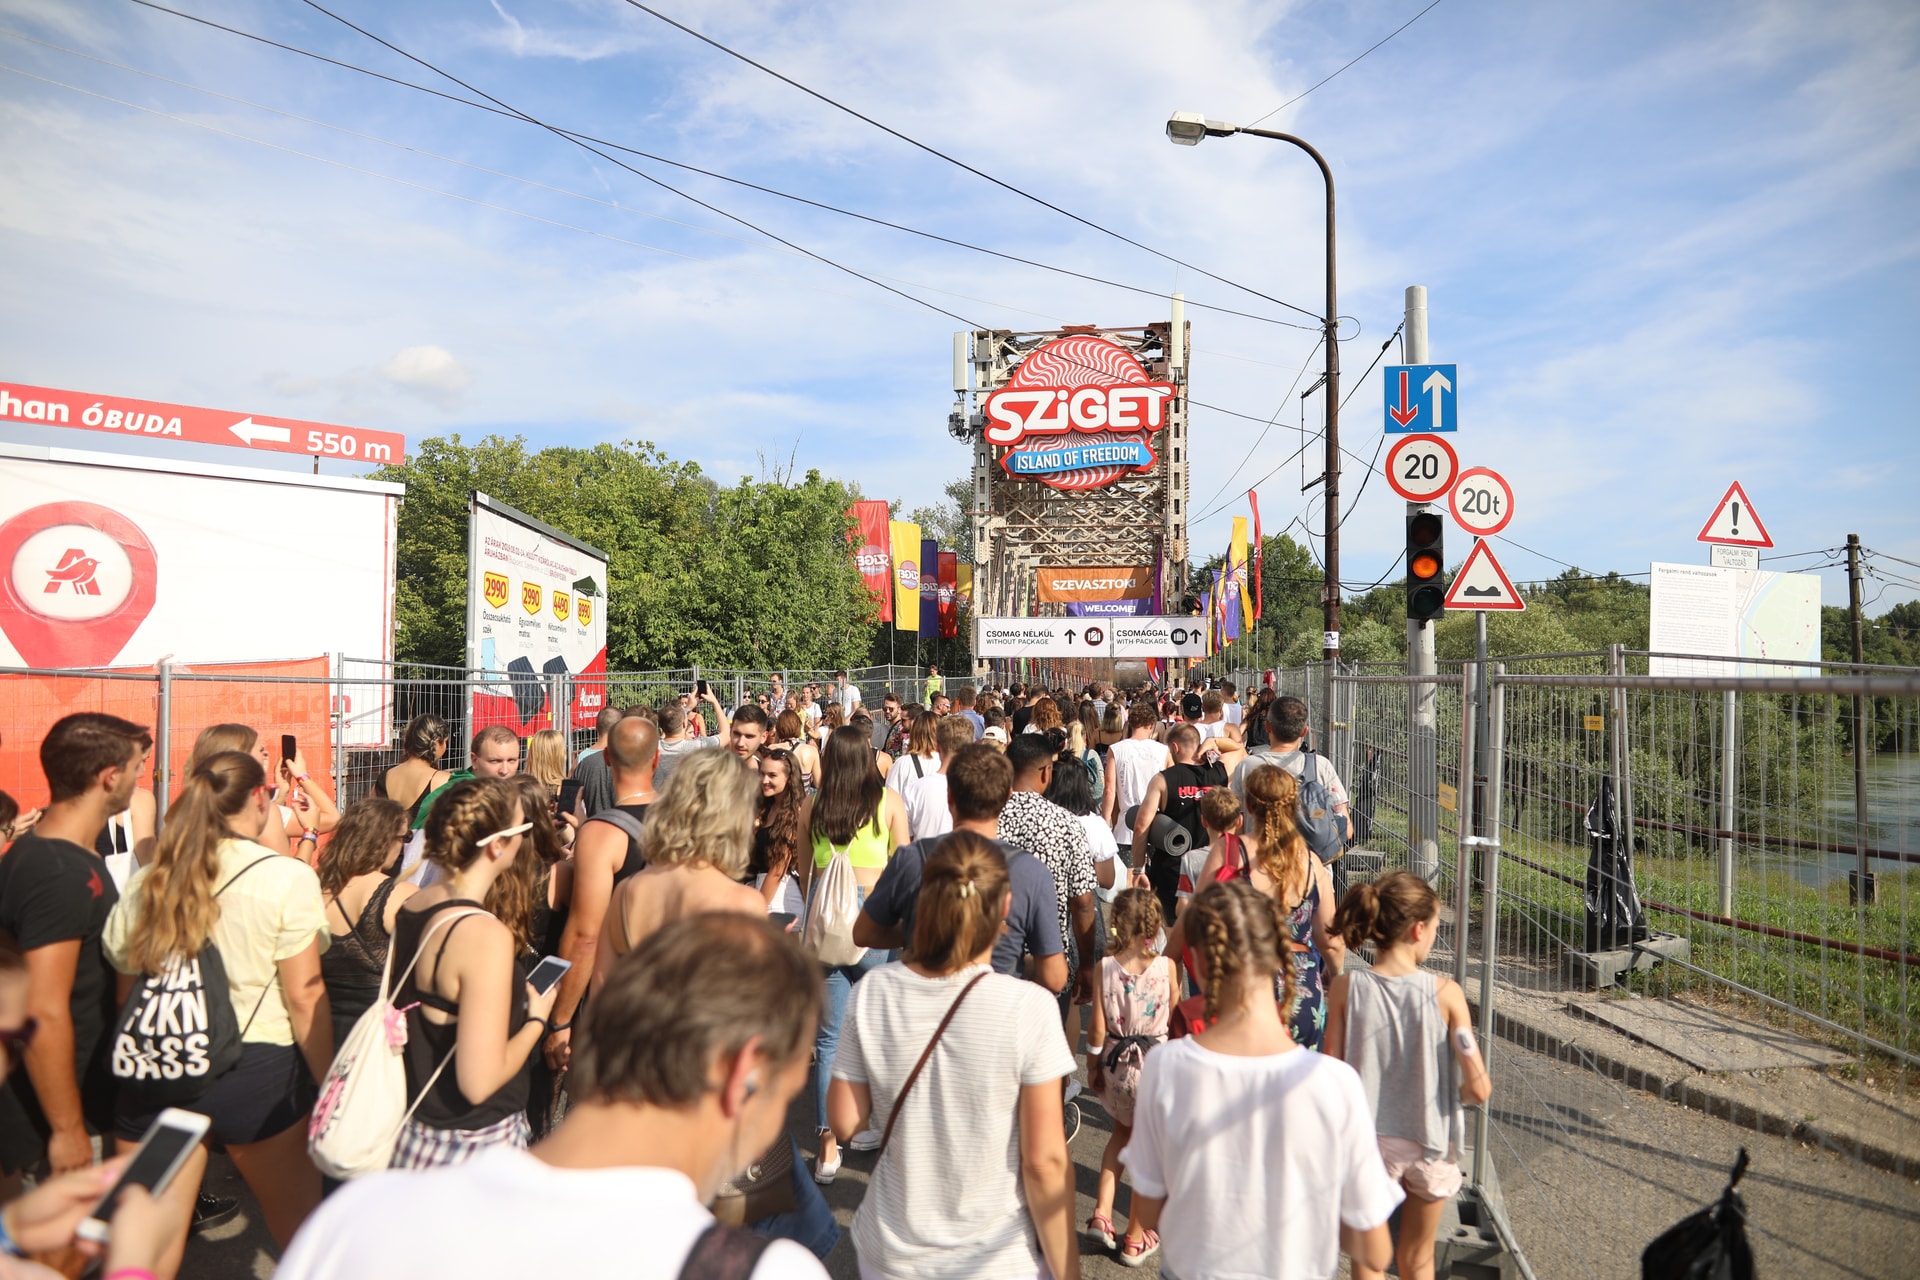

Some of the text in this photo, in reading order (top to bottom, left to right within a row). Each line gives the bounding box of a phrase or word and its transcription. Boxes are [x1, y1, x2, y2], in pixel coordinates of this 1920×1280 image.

[82, 403, 182, 436] ÓBUDA
[307, 430, 357, 456] 550
[364, 442, 391, 461] m
[1017, 446, 1140, 470] ISLAND OF FREEDOM
[1404, 453, 1439, 480] 20
[1717, 548, 1754, 558] FORGALMI REND
[485, 577, 507, 600] 2990
[1052, 579, 1136, 591] SZEVASZTOK!
[523, 587, 540, 607] 2990
[553, 595, 569, 614] 4490
[578, 602, 590, 619] 8990
[1085, 604, 1136, 613] WELCOME!
[986, 628, 1055, 638] CSOMAG NÉLKÜL
[1116, 629, 1168, 637] CSOMAGGAL
[1116, 637, 1168, 645] WITH PACKAGE
[579, 687, 602, 708] Auchan
[112, 1032, 211, 1081] BASS
